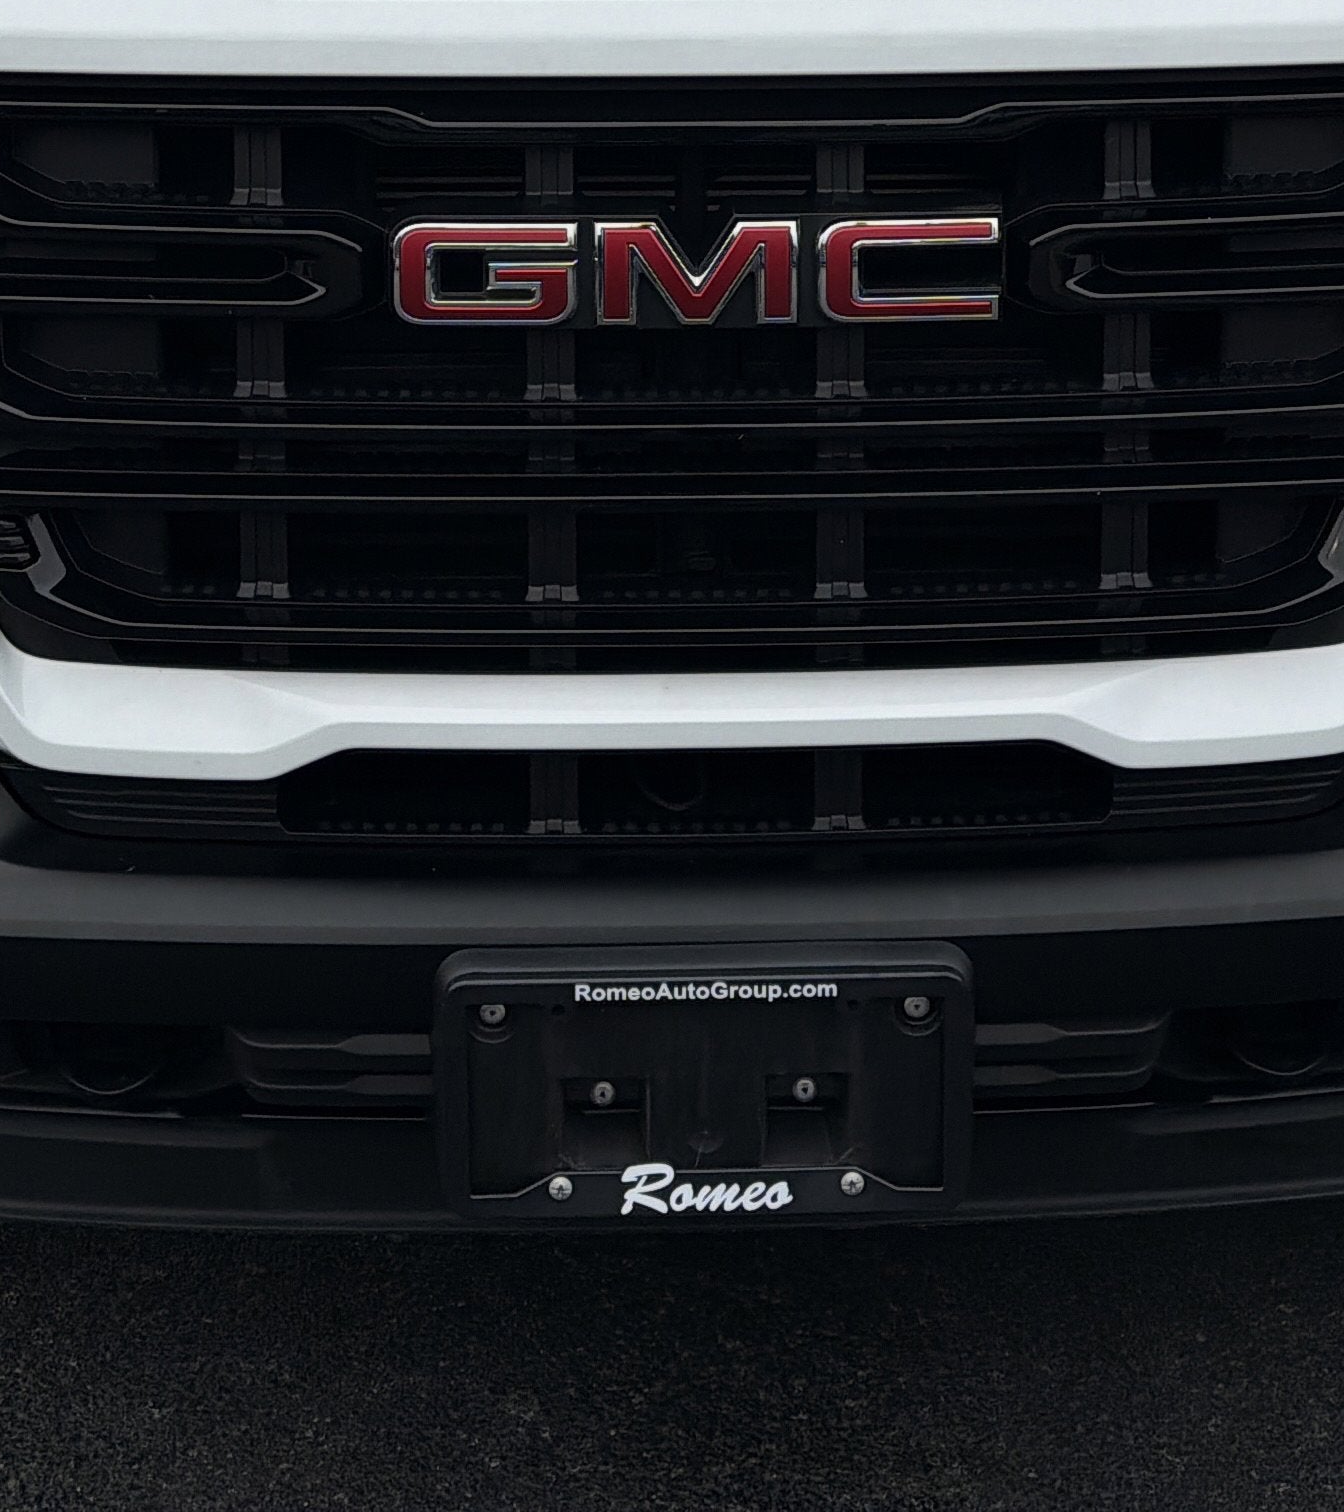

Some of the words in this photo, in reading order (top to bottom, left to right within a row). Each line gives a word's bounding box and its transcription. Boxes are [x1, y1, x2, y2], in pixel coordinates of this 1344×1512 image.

[393, 217, 999, 325] GMC
[574, 981, 838, 1002] RomeoAutoGroup.com
[620, 1163, 793, 1215] Romeo
